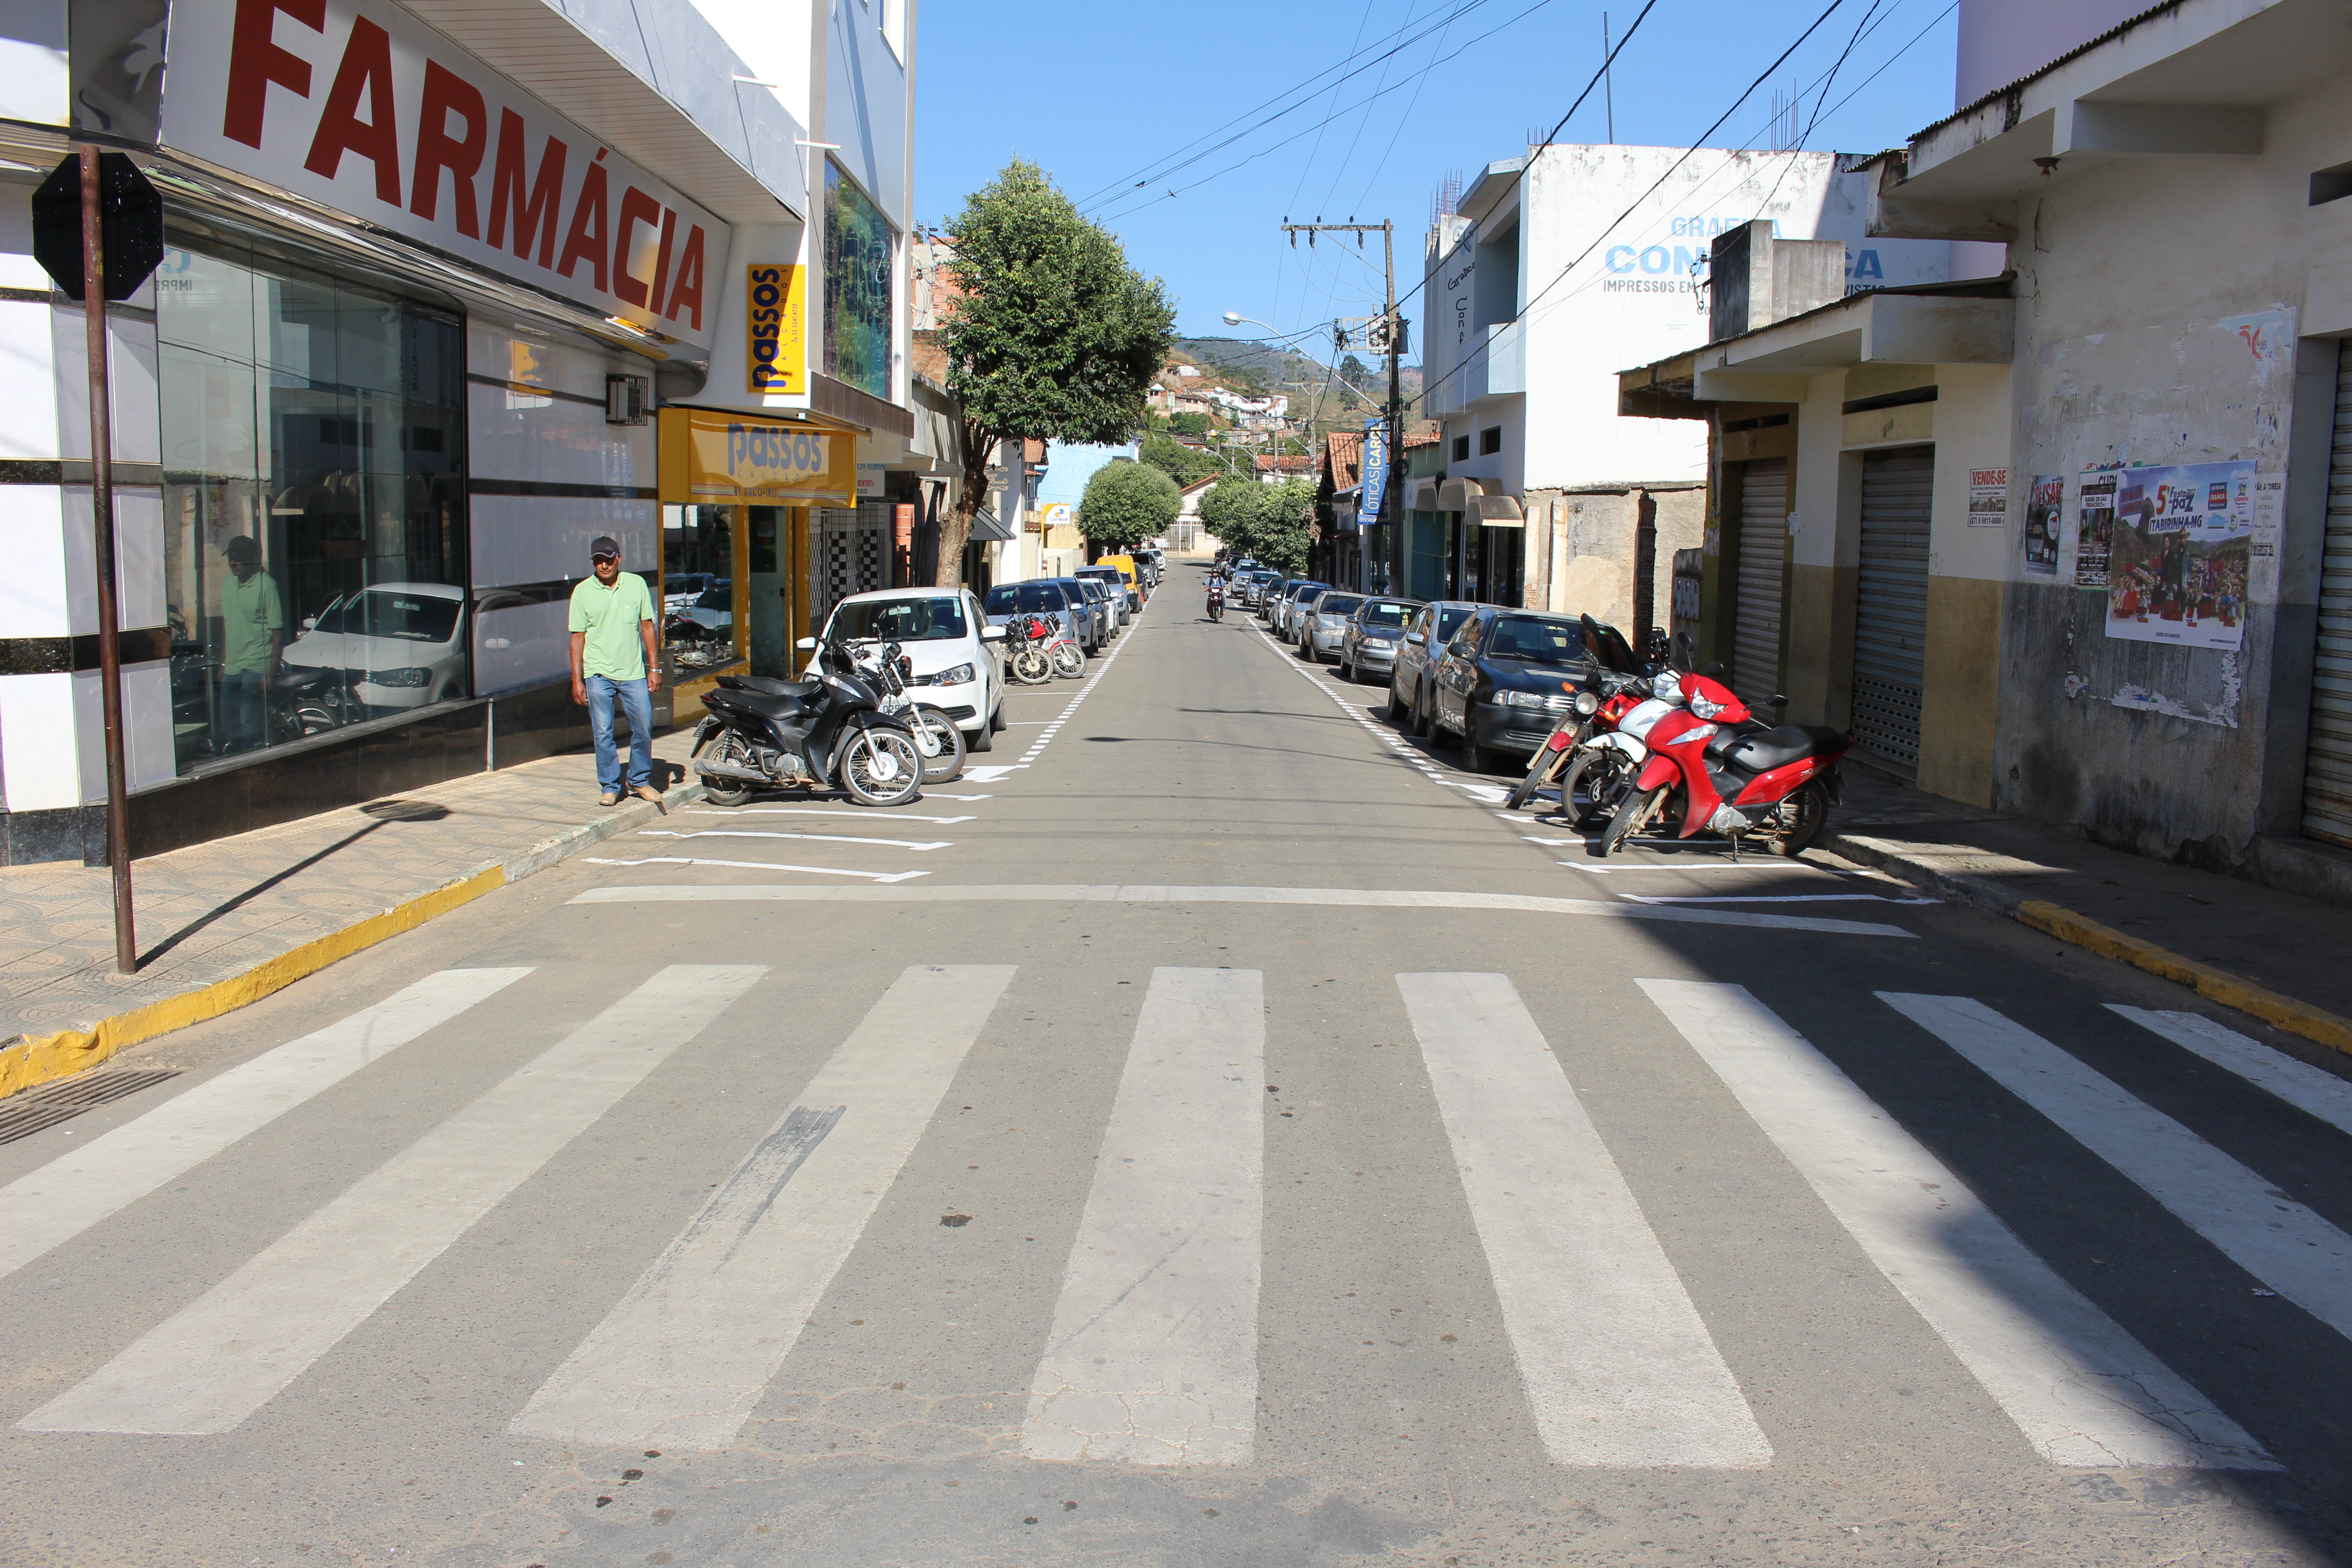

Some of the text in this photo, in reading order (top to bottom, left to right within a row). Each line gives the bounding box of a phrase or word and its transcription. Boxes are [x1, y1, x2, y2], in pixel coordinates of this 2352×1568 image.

[223, 0, 705, 332] FARMÁCIA
[1603, 280, 1675, 293] IMPRESSOS
[752, 269, 786, 387] passos
[1972, 470, 2006, 485] VENDE-SE
[734, 484, 777, 498] BY ARCO-ÍRIS
[1365, 470, 1380, 510] ÓTICAS
[2170, 486, 2186, 498] Festa
[2149, 514, 2203, 532] ITABIRINHA-MG
